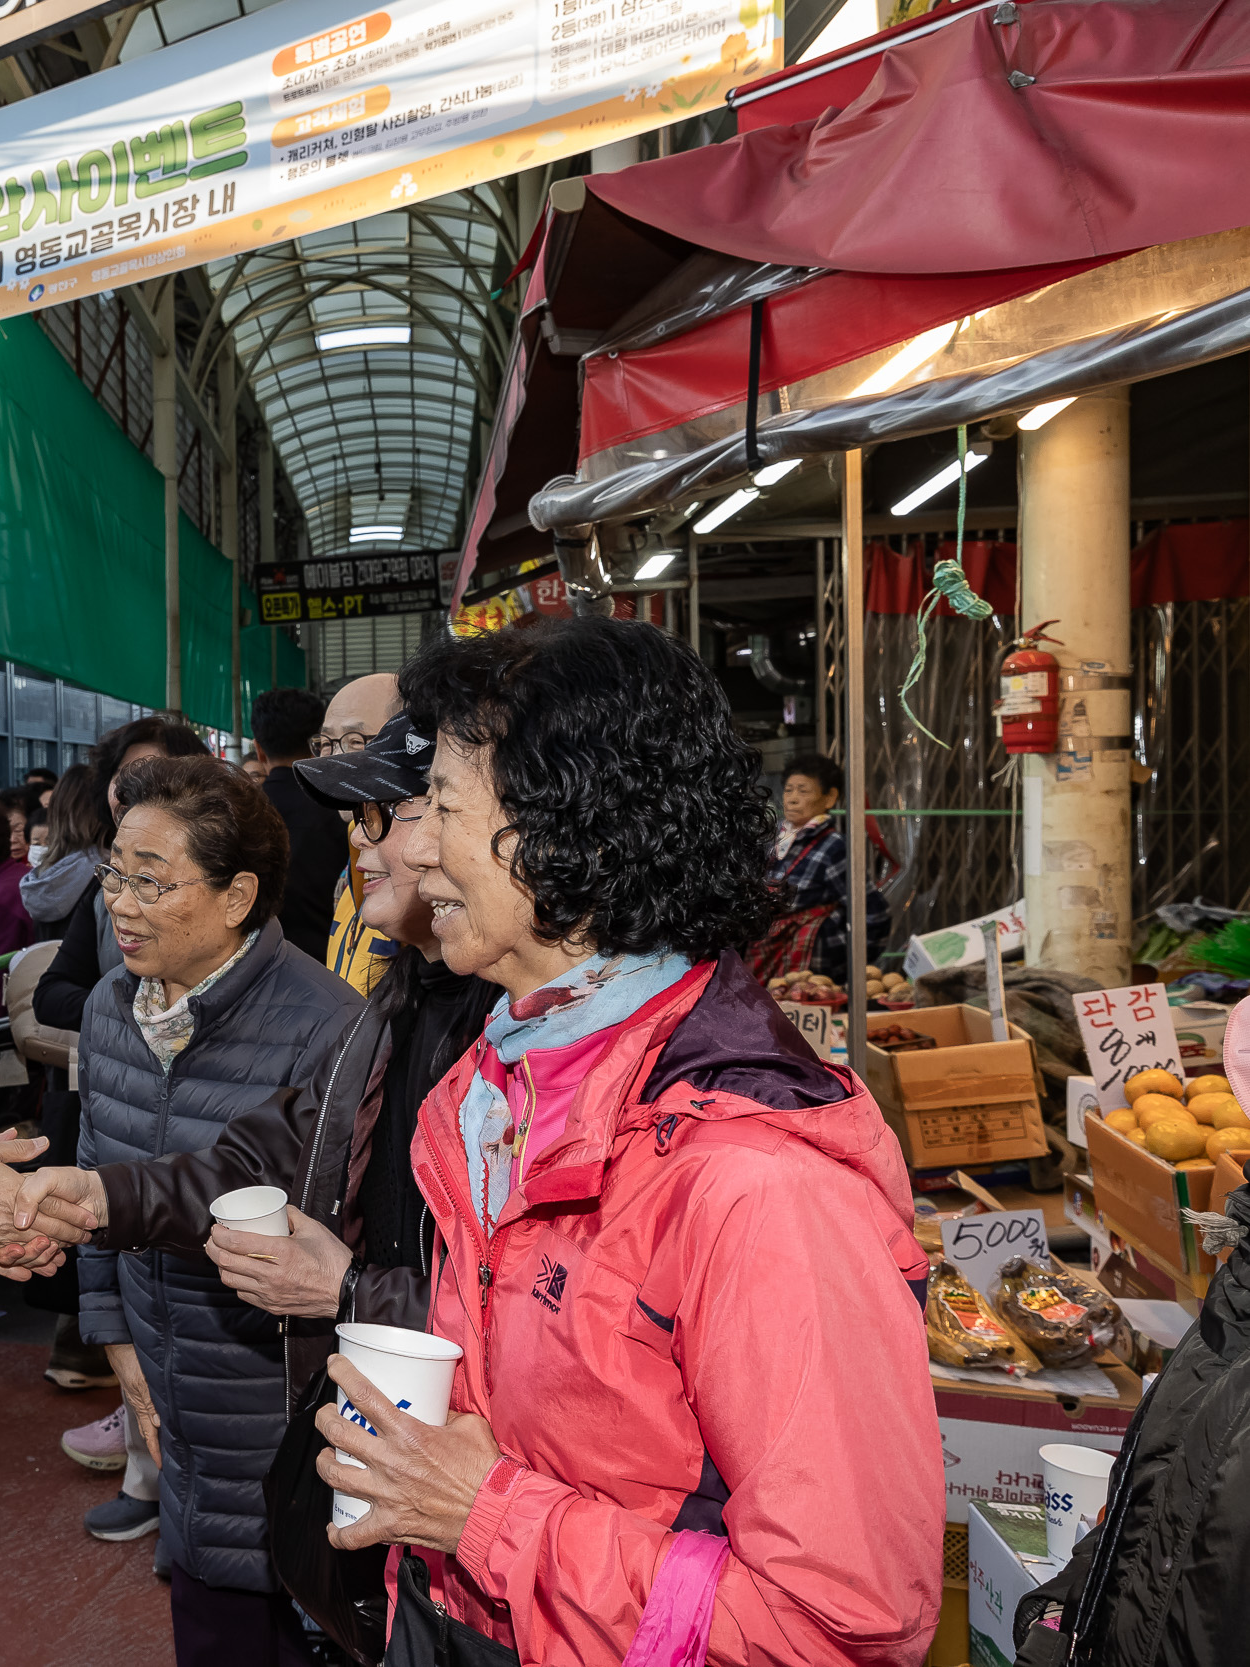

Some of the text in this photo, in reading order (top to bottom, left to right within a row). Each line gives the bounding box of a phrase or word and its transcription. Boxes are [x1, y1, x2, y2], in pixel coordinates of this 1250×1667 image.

[341, 123, 378, 147] 인형탈
[14, 188, 199, 277] 영동교골목시장
[208, 182, 236, 217] 내
[339, 781, 376, 800] DYNAFIT
[375, 777, 412, 796] DYNAFIT
